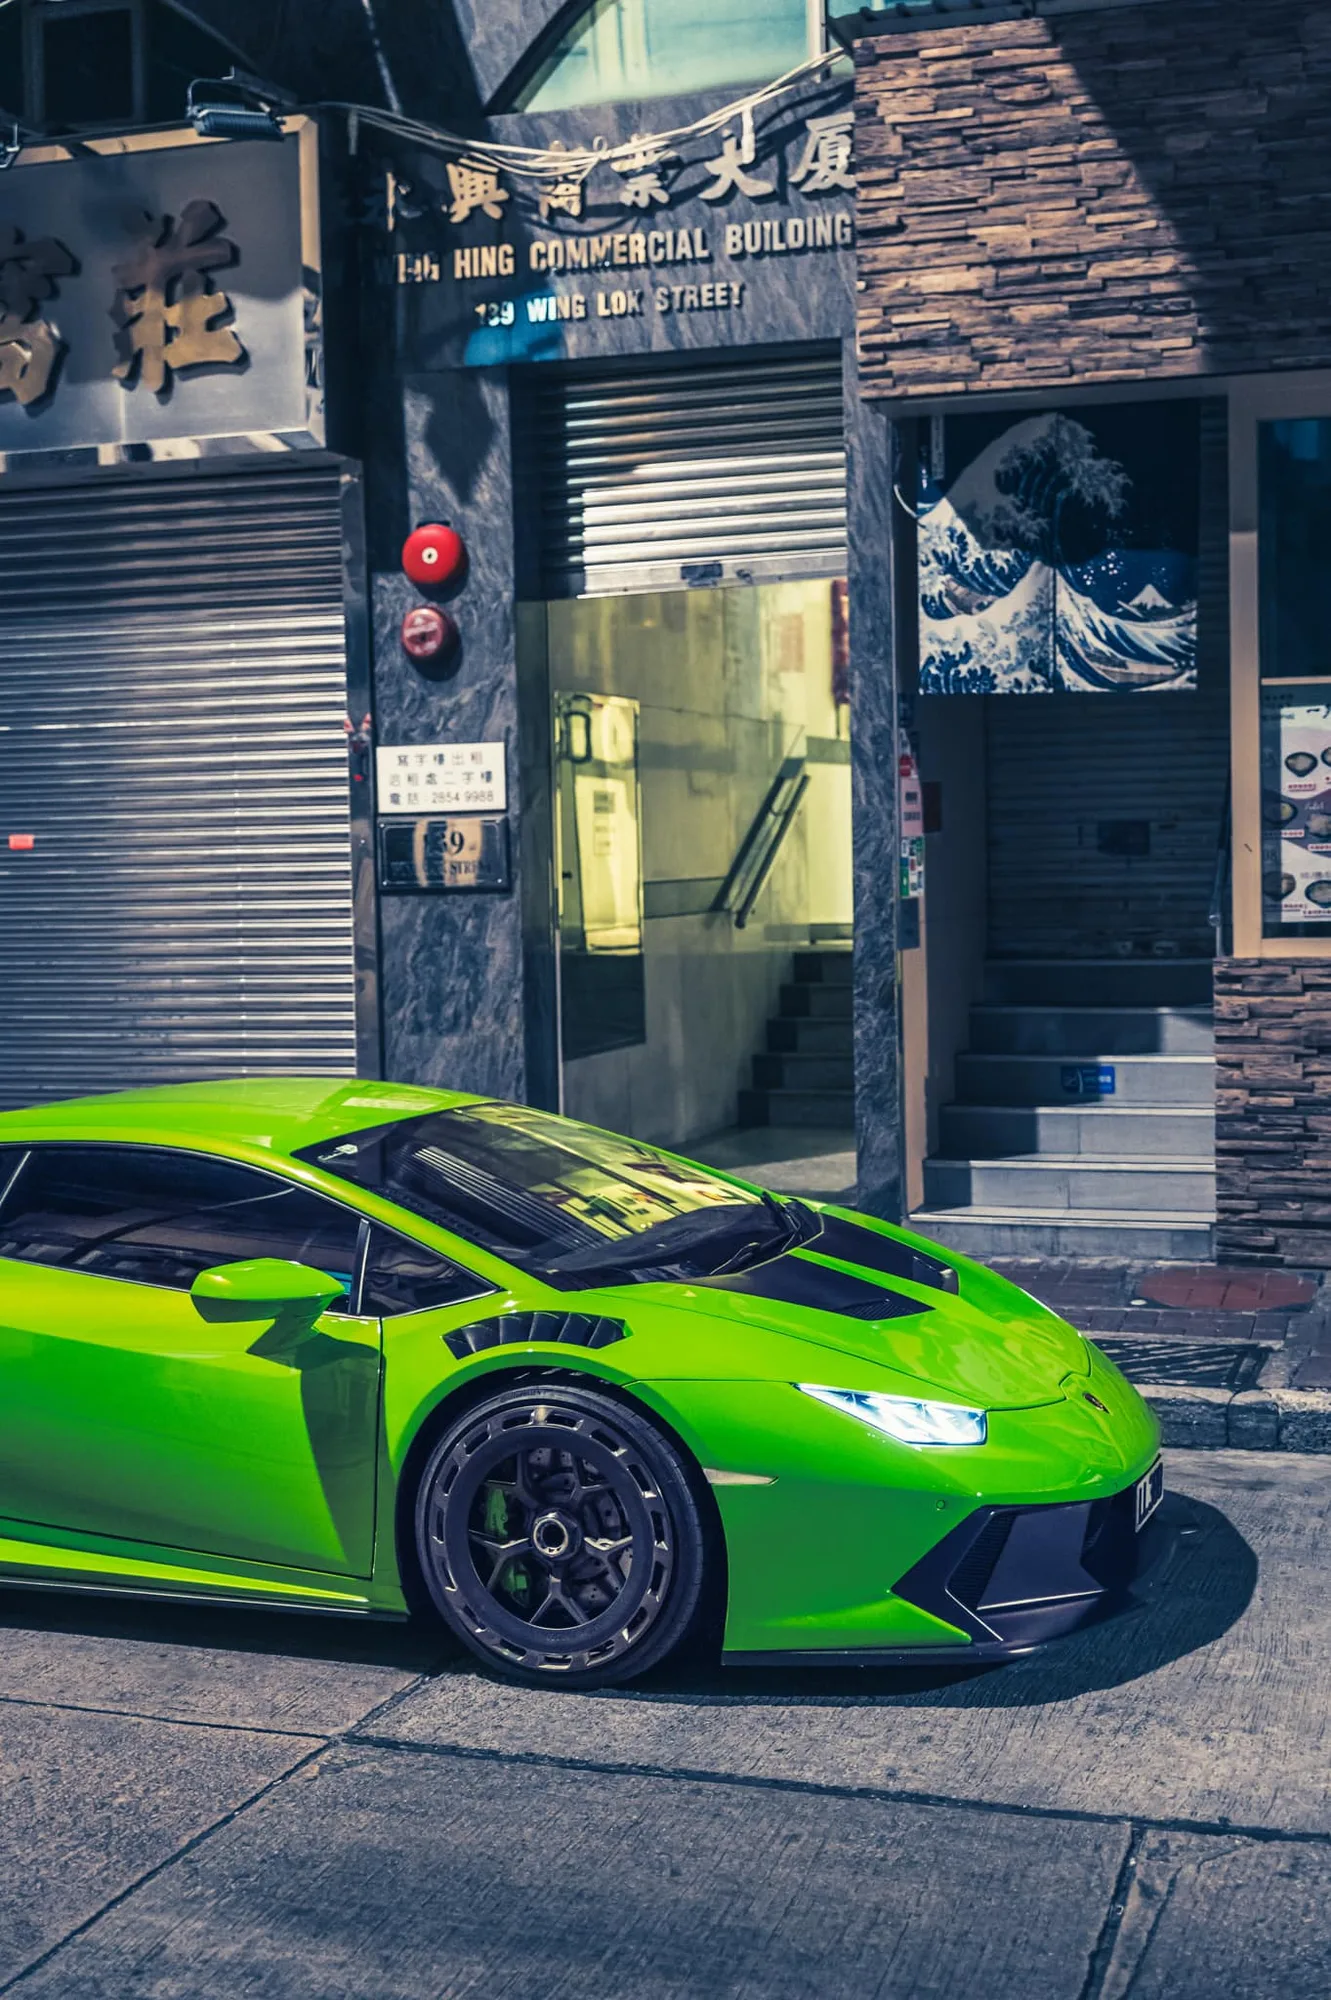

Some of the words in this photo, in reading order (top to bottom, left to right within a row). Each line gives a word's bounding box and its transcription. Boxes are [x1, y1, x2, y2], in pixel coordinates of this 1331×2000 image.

[454, 242, 515, 280] HING
[529, 227, 710, 273] COMMERCIAL
[724, 213, 853, 255] BUILDING
[474, 300, 515, 327] 139
[527, 295, 586, 323] WING
[597, 288, 640, 318] LOK
[656, 281, 747, 313] STREET
